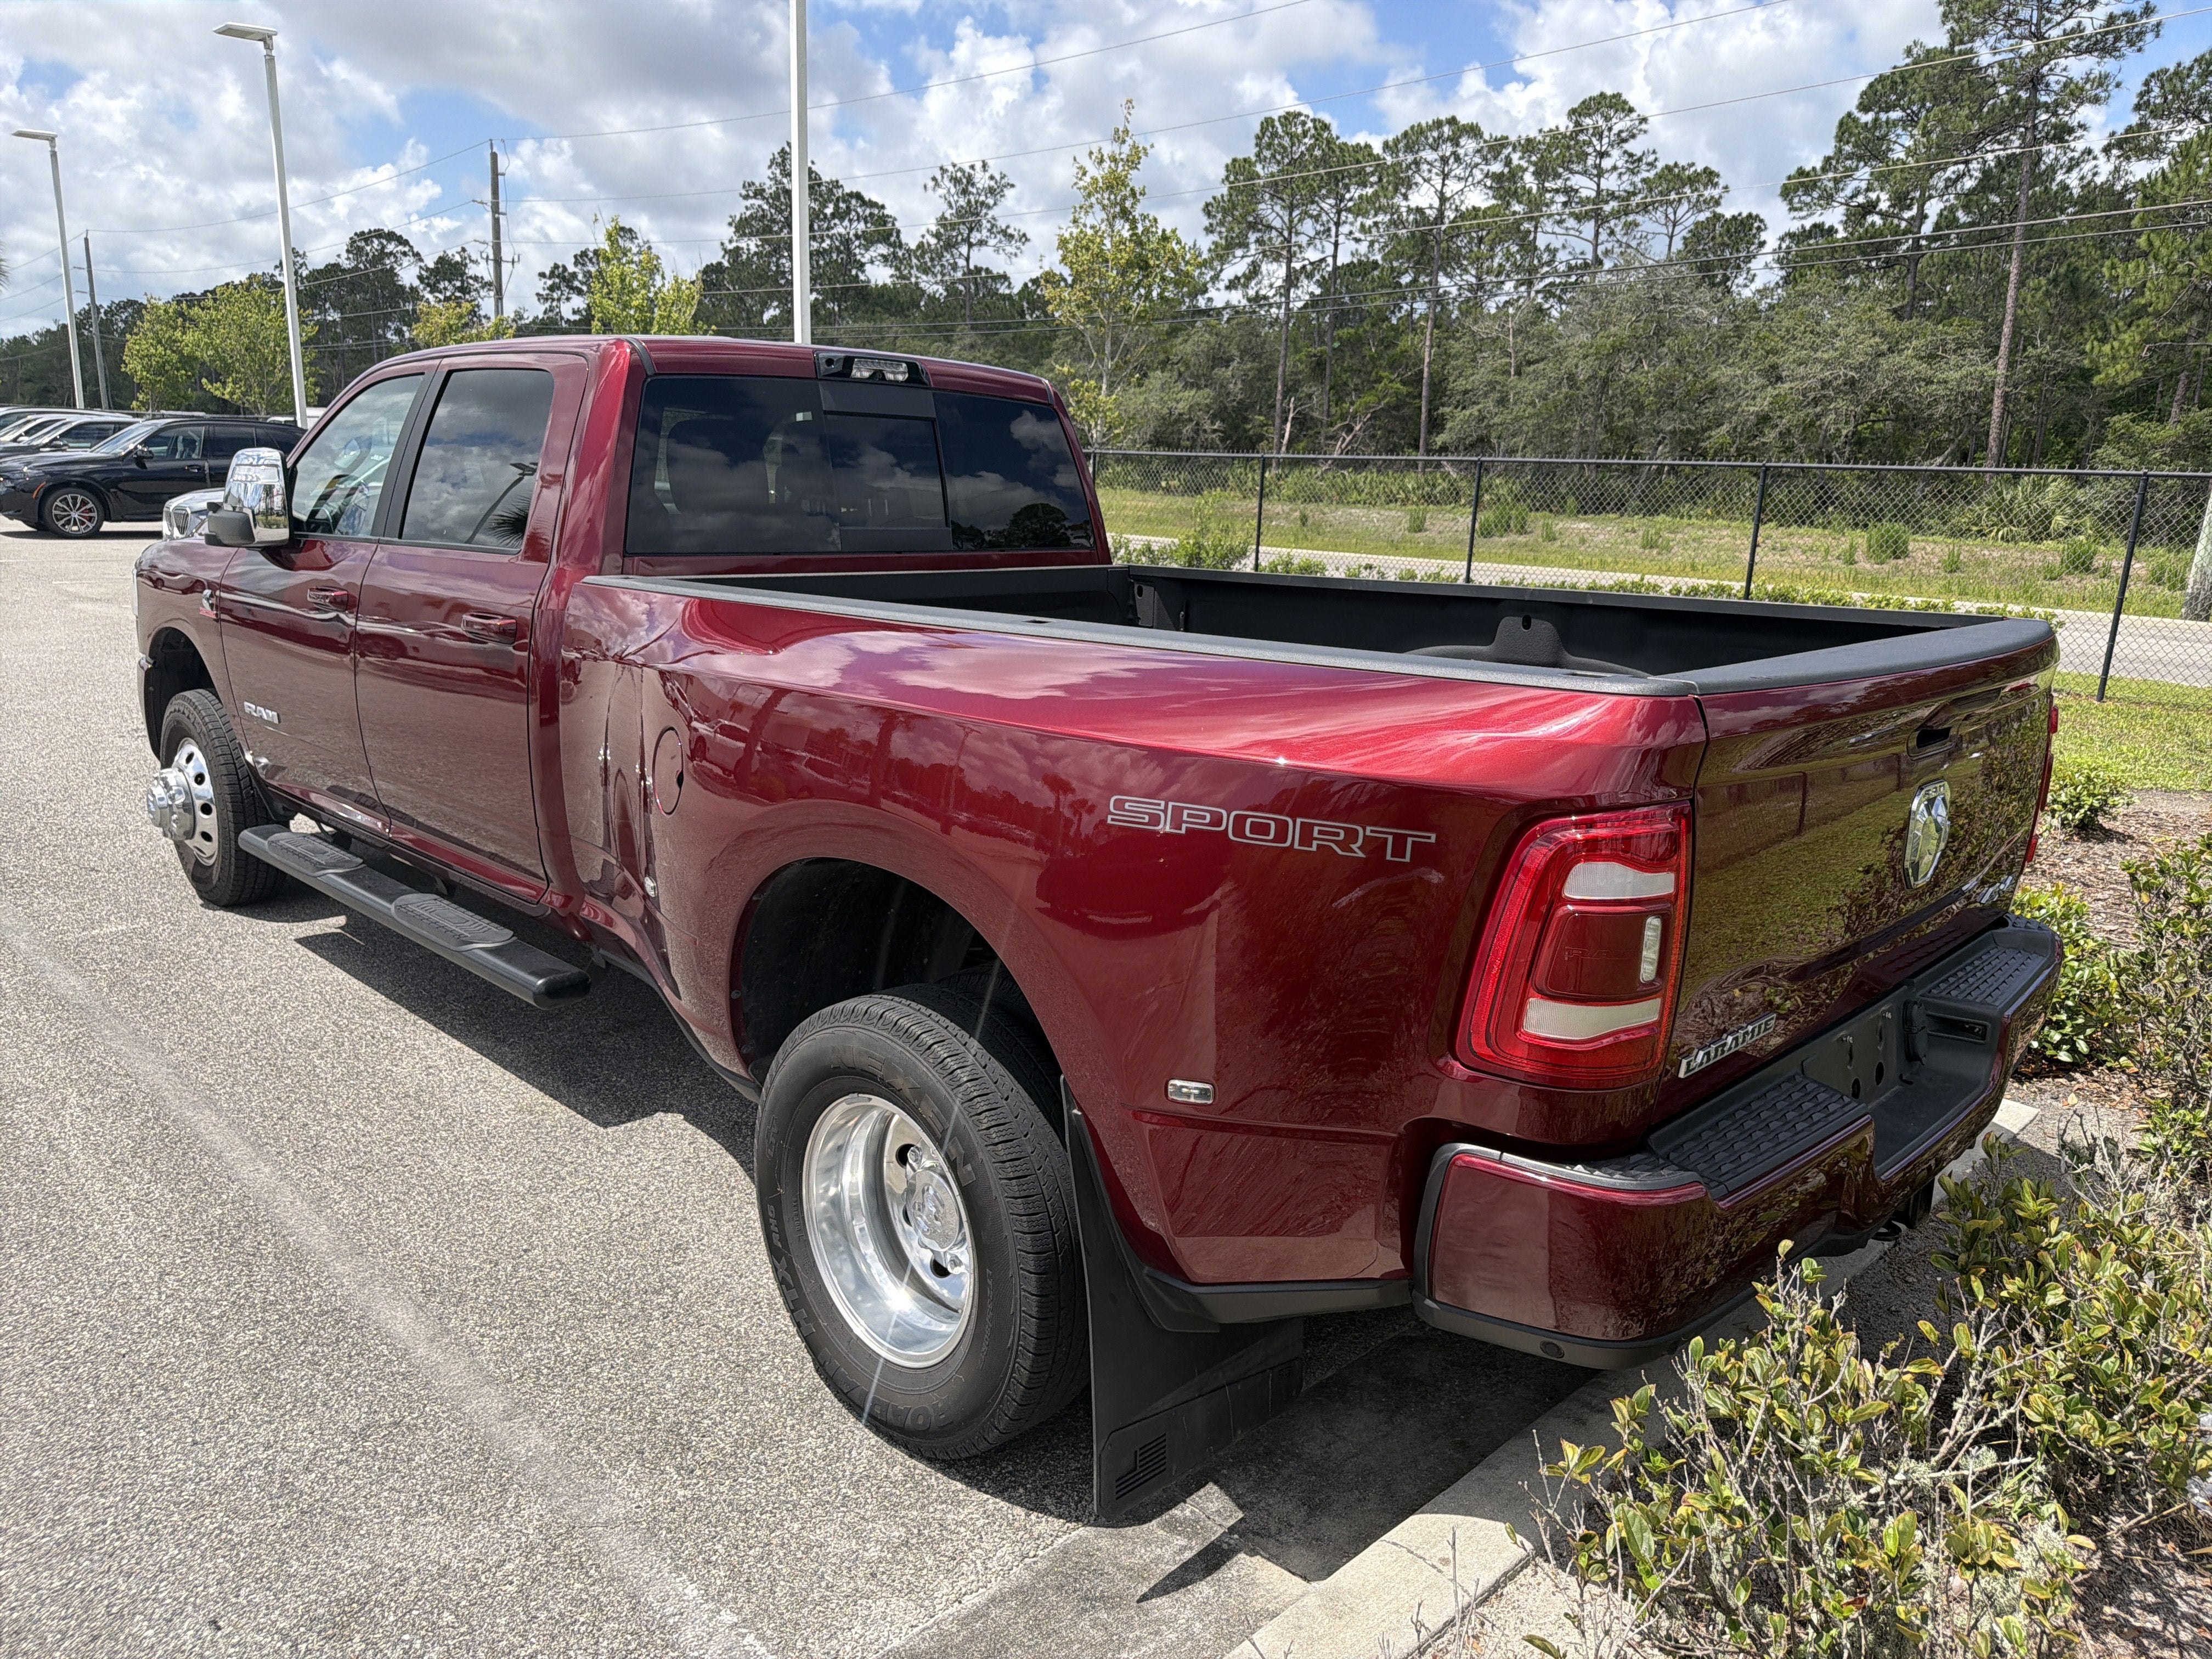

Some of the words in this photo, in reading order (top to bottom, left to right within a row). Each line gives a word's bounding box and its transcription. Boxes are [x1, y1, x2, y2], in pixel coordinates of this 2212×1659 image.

[244, 701, 279, 725] RAM
[1107, 794, 1436, 863] SPORT
[1678, 1013, 1777, 1079] LARAMIE
[831, 1044, 977, 1188] NEXEN
[766, 1203, 782, 1249] RH5
[771, 1254, 817, 1337] HTX
